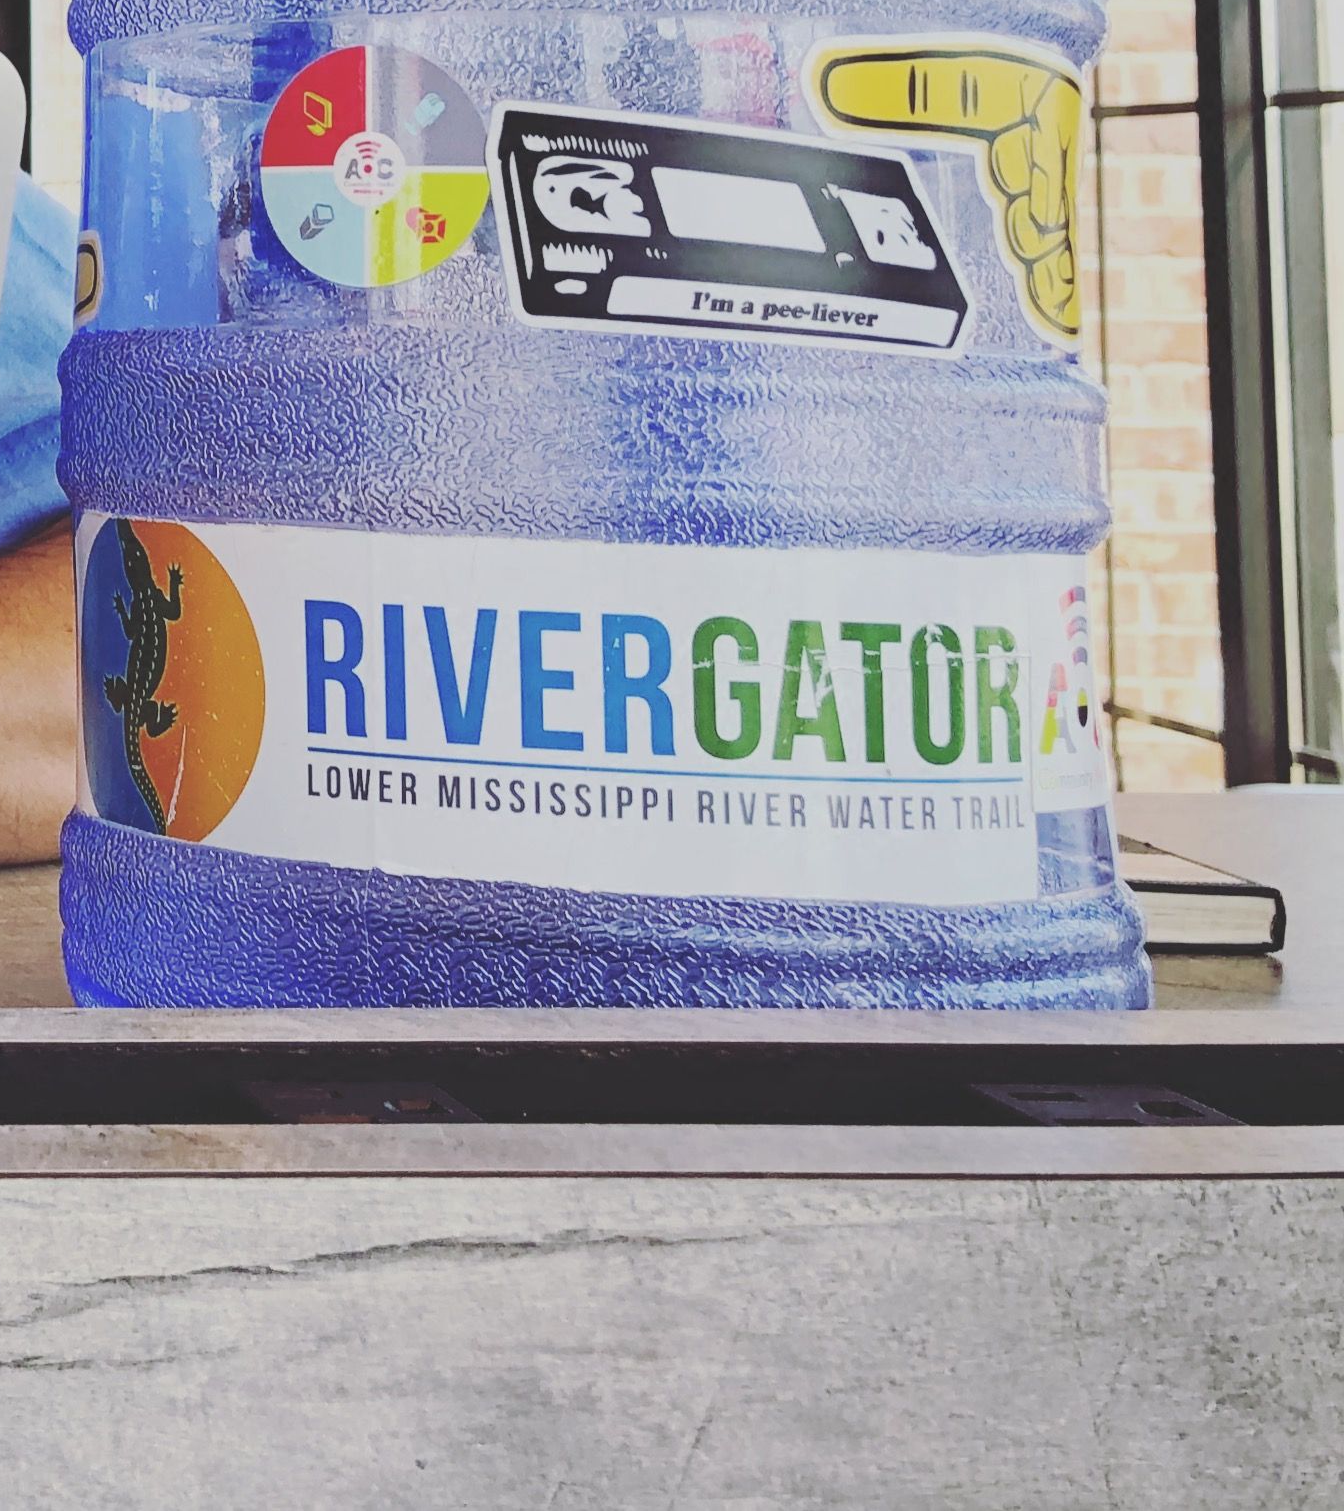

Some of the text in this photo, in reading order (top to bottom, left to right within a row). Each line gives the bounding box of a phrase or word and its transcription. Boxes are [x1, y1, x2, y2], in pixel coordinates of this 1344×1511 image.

[691, 291, 879, 327] I'm a pee-liever
[304, 598, 1022, 765] RIVERGATOR
[307, 763, 1026, 830] LOWER MISSISSIPPI RIVER WATER TRAIL
